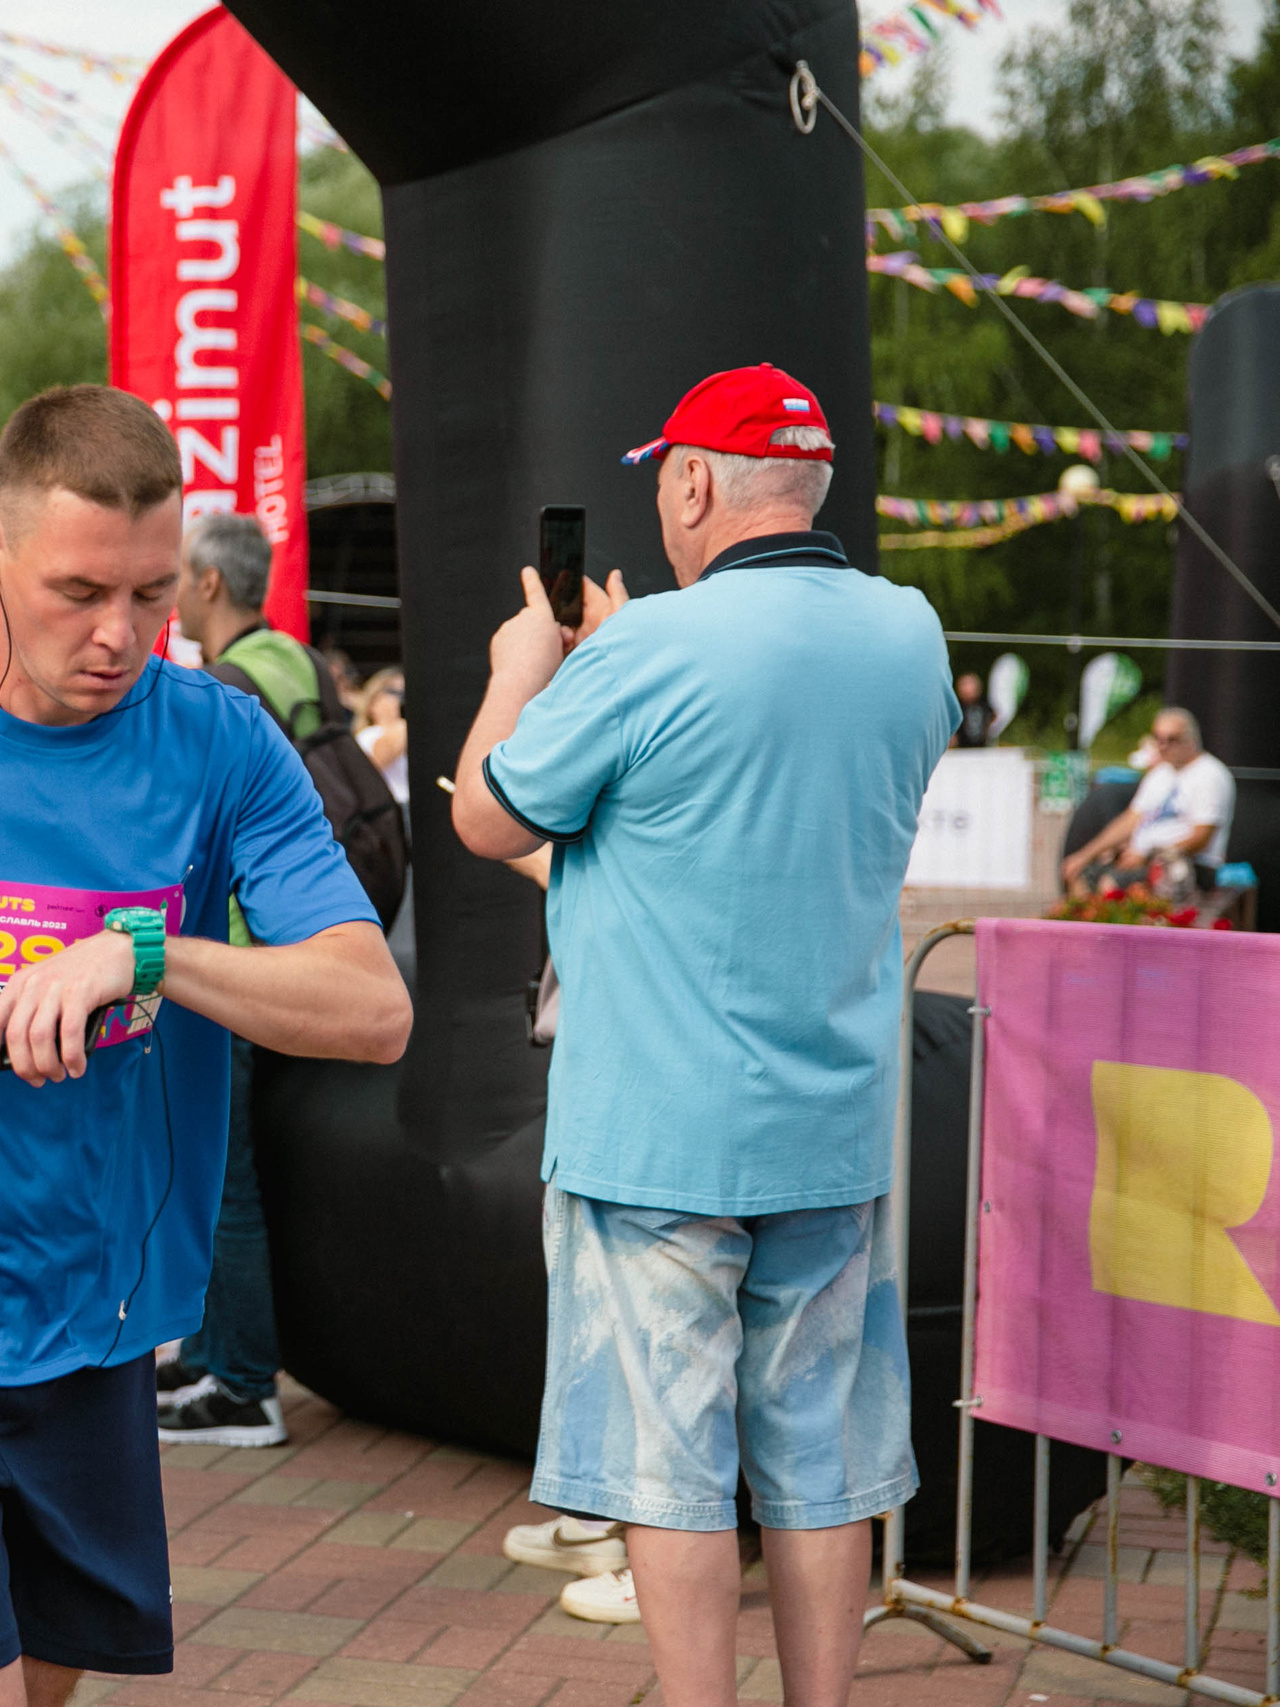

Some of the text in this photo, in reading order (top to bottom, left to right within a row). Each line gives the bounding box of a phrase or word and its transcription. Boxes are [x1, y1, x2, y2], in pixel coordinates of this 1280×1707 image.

[254, 434, 289, 544] HOTEL
[42, 920, 67, 930] 2023
[1089, 1060, 1280, 1327] R
